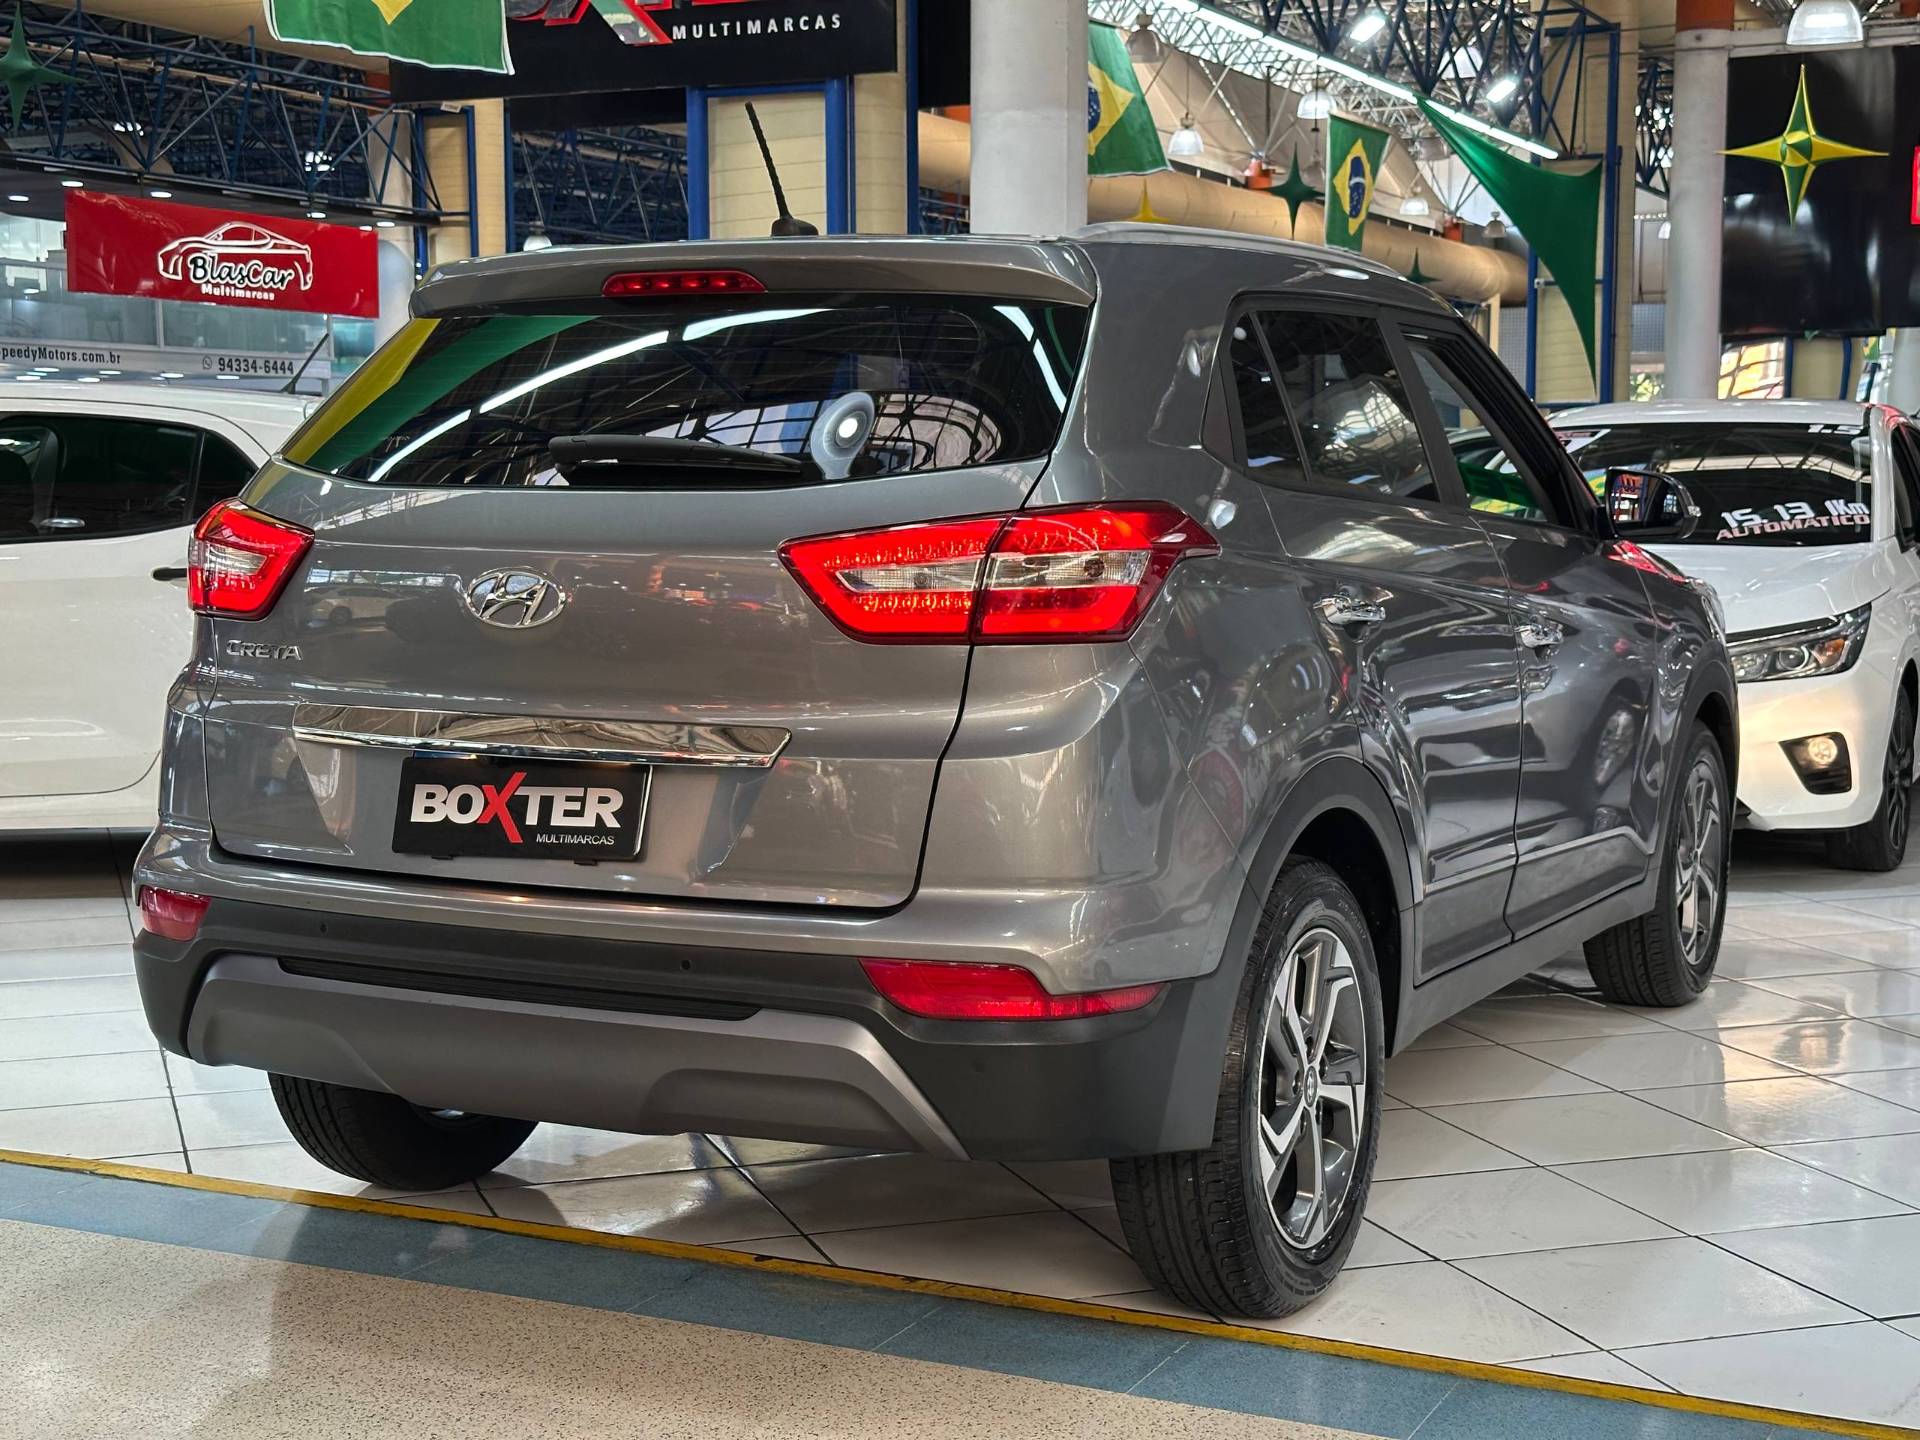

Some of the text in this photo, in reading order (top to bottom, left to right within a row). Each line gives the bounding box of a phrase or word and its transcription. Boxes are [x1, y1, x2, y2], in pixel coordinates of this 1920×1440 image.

[672, 13, 842, 40] MULTIMARCAS
[187, 252, 295, 290] BlasCar
[201, 283, 275, 300] Multimarcas
[1, 346, 121, 364] peedyMotors.com.br
[218, 357, 294, 375] 94334-6444
[1716, 514, 1871, 541] AUTOMATICO
[226, 639, 302, 660] CRETA
[410, 771, 624, 844] BOXTER
[536, 833, 615, 845] MULTIMARCAS
